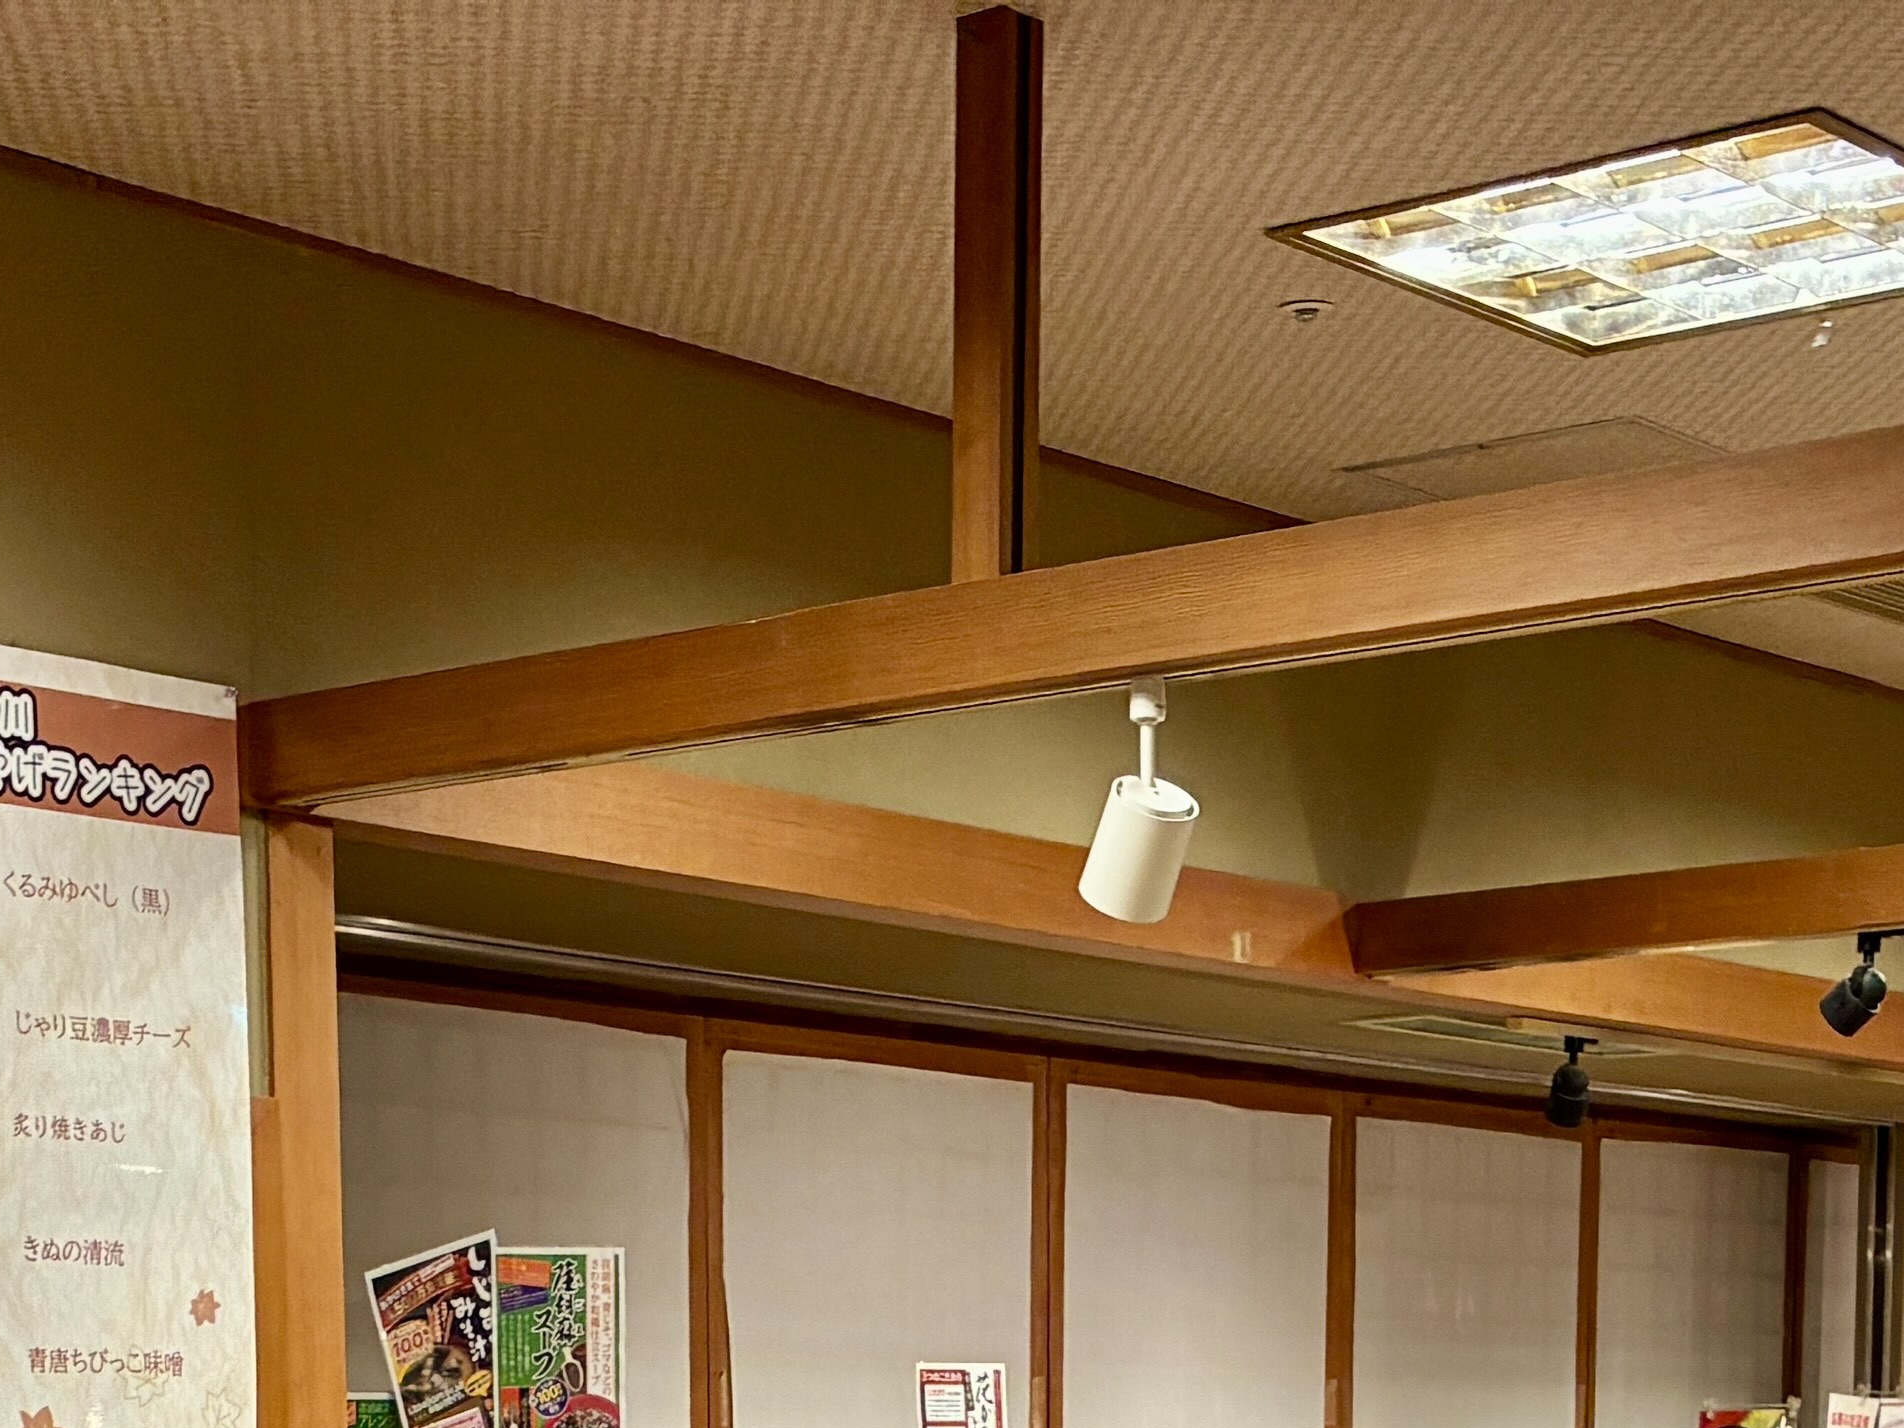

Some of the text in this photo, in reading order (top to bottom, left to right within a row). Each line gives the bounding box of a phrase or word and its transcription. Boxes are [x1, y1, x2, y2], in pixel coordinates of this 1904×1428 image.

[14, 1009, 192, 1049] じゃり豆濃厚チーズ
[12, 1112, 127, 1144] 炙り焼きあじ
[22, 1235, 125, 1268] きぬの清流
[28, 1345, 185, 1378] 青唐ちびっこ味噌
